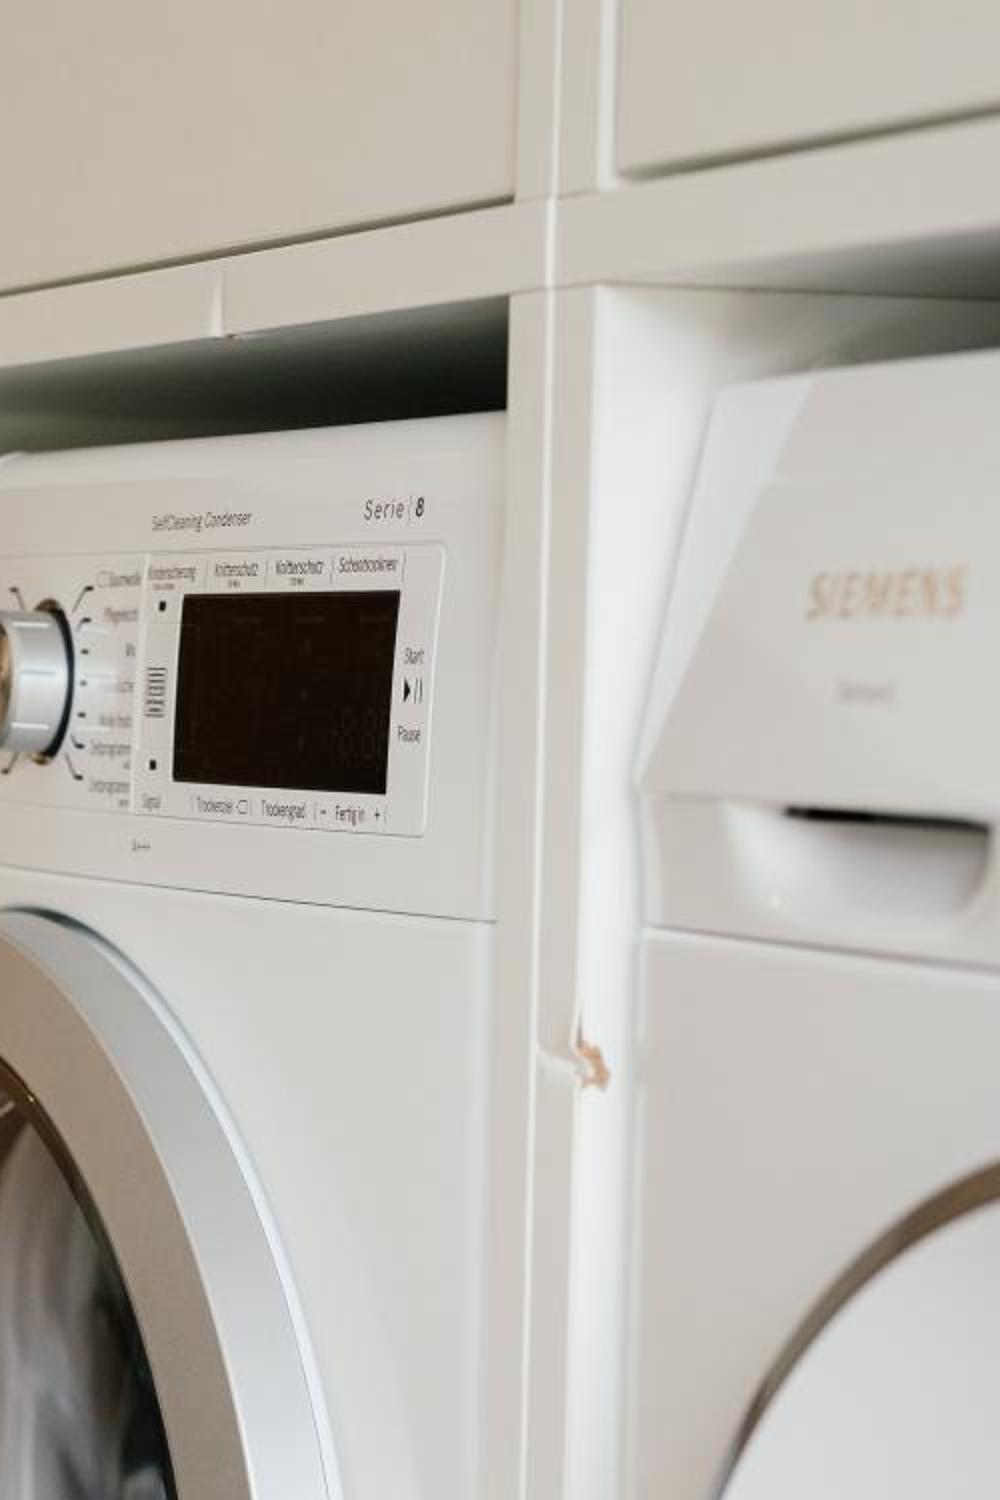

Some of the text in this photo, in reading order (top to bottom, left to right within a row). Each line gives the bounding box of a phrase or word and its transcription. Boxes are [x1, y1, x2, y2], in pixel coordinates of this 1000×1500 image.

[363, 496, 426, 521] Serie 8
[203, 510, 253, 528] Condenser
[404, 647, 425, 665] Start
[398, 725, 421, 744] Pause
